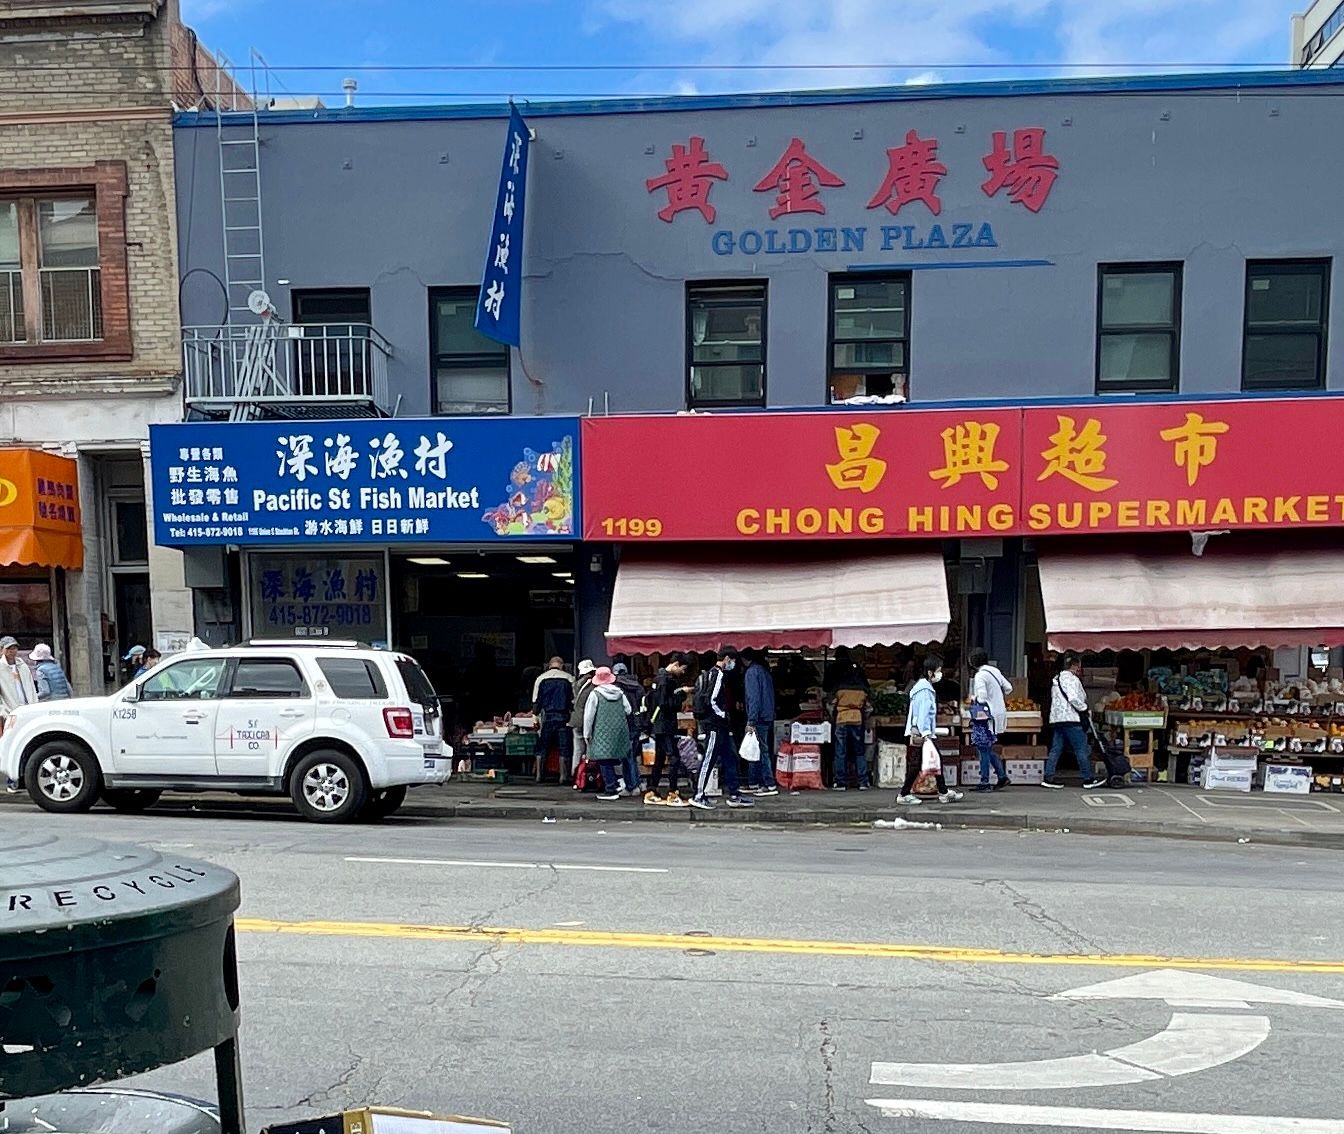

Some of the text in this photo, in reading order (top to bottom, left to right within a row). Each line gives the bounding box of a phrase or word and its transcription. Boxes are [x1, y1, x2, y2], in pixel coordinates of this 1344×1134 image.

[711, 223, 999, 256] GOLDEN PLAZA
[276, 432, 454, 482] 深海漁村
[825, 412, 1230, 493] 昌興超市
[168, 466, 239, 483] 野生海魚
[170, 488, 239, 506] 批發零售
[253, 487, 480, 512] Pacific St Fish Market
[163, 511, 249, 523] Wholesale & Retail
[371, 518, 429, 535] 日日新鮮
[601, 517, 662, 536] 1199
[736, 507, 885, 535] CHONG
[908, 504, 1015, 532] HING
[170, 527, 185, 538] Tel:
[260, 567, 378, 602] 深海漁村
[269, 605, 372, 625] 415-872-9018
[8, 864, 206, 911] RECYCLE
